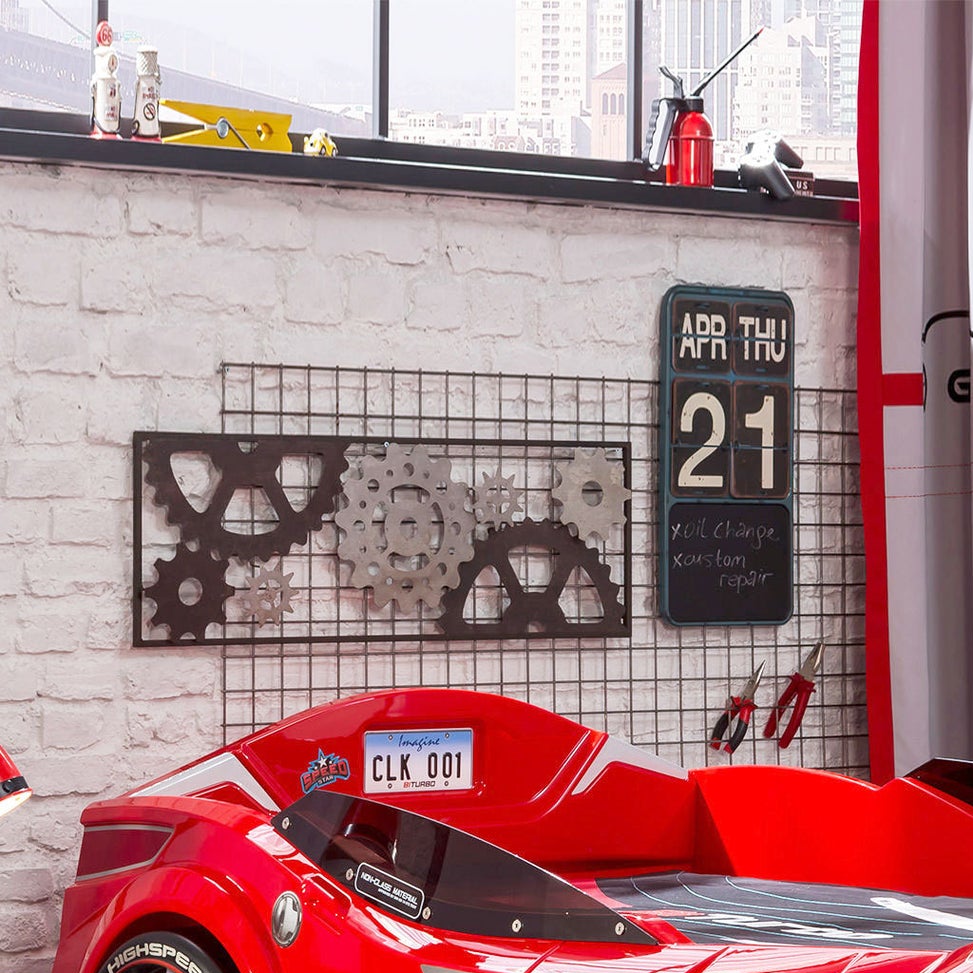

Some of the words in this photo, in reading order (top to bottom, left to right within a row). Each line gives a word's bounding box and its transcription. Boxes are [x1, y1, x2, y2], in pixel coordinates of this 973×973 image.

[679, 313, 727, 361] APR
[738, 315, 787, 363] THU
[678, 391, 775, 490] 21
[719, 568, 775, 594] repair
[398, 734, 441, 752] Imagine
[302, 760, 349, 789] SPEED
[317, 775, 334, 785] STAR
[372, 753, 411, 782] CLK
[427, 751, 462, 779] 001
